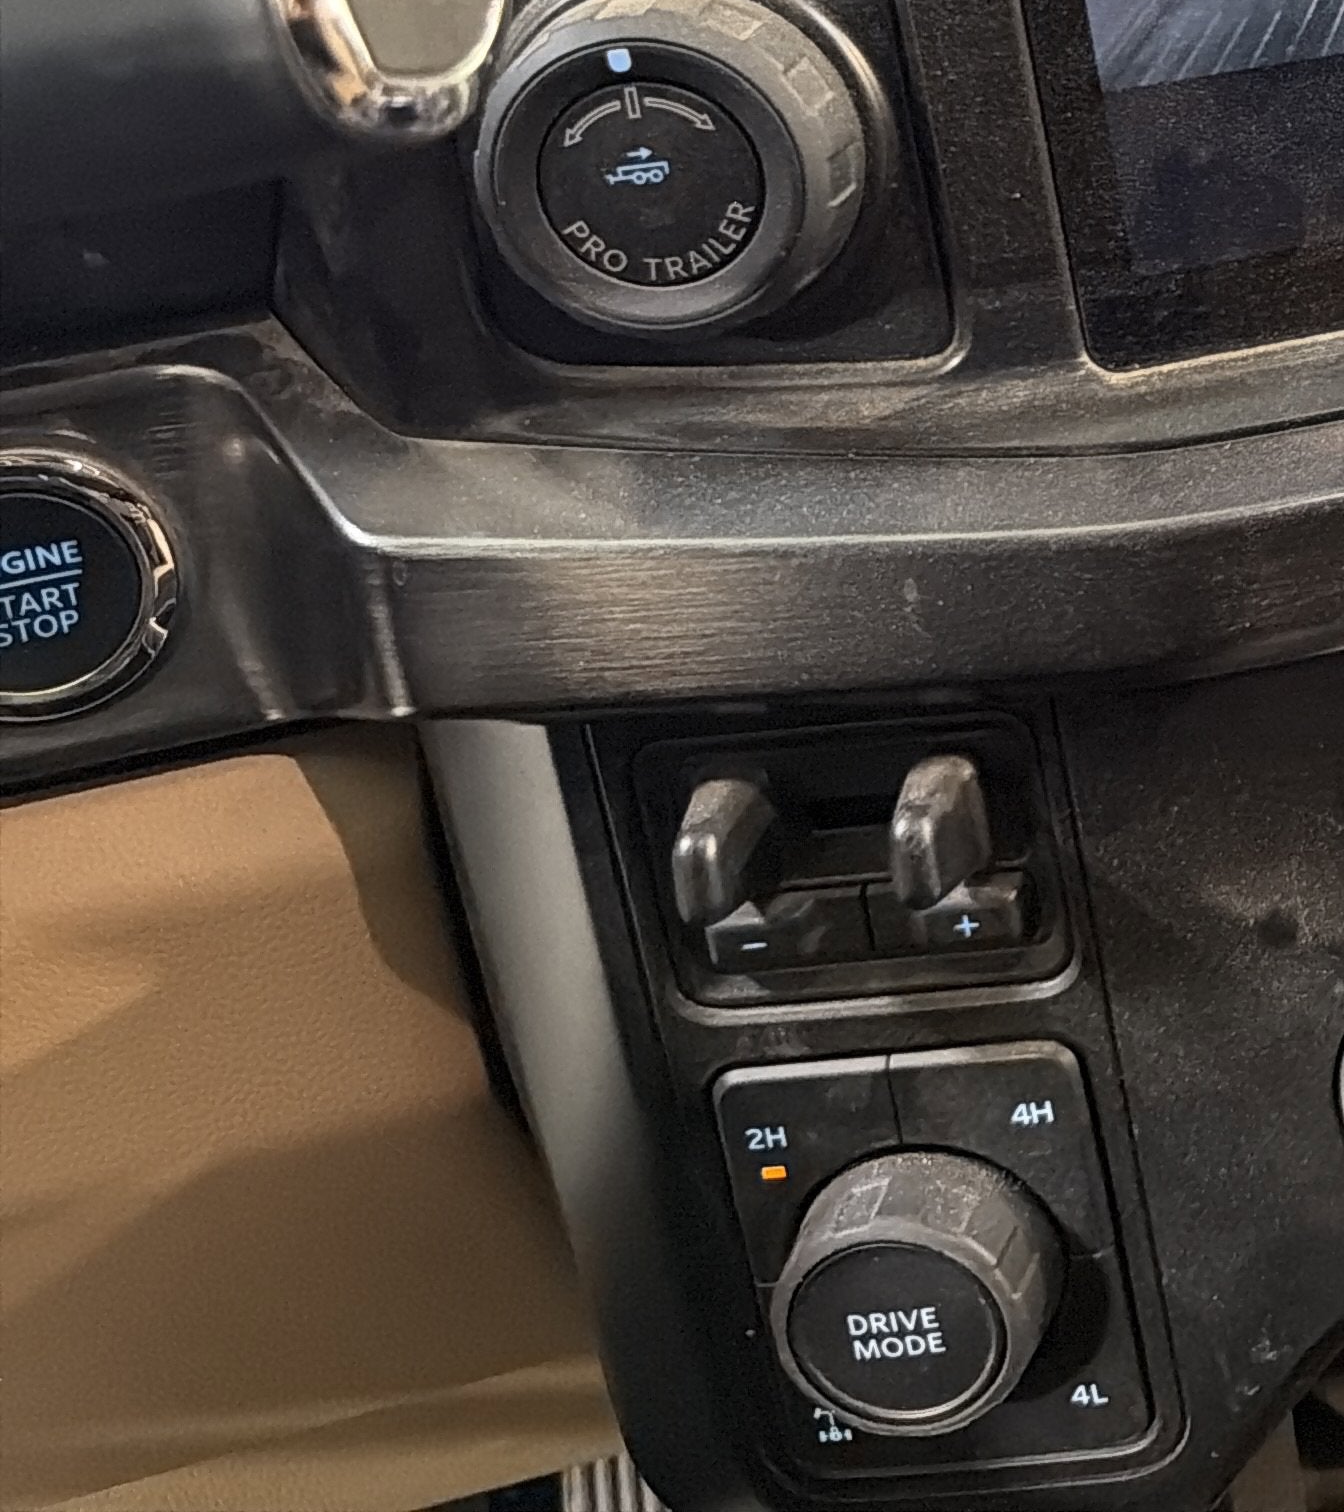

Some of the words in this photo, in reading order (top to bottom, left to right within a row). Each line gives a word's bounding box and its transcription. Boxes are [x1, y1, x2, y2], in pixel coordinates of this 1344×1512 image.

[561, 220, 628, 272] PRO
[643, 200, 756, 281] TRAILER
[0, 539, 83, 575] GINE
[0, 582, 80, 620] TART
[1010, 1100, 1055, 1126] 4H
[745, 1126, 788, 1151] 2H
[846, 1306, 940, 1337] DRIVE
[852, 1331, 947, 1362] MODE
[1070, 1383, 1110, 1407] 4L
